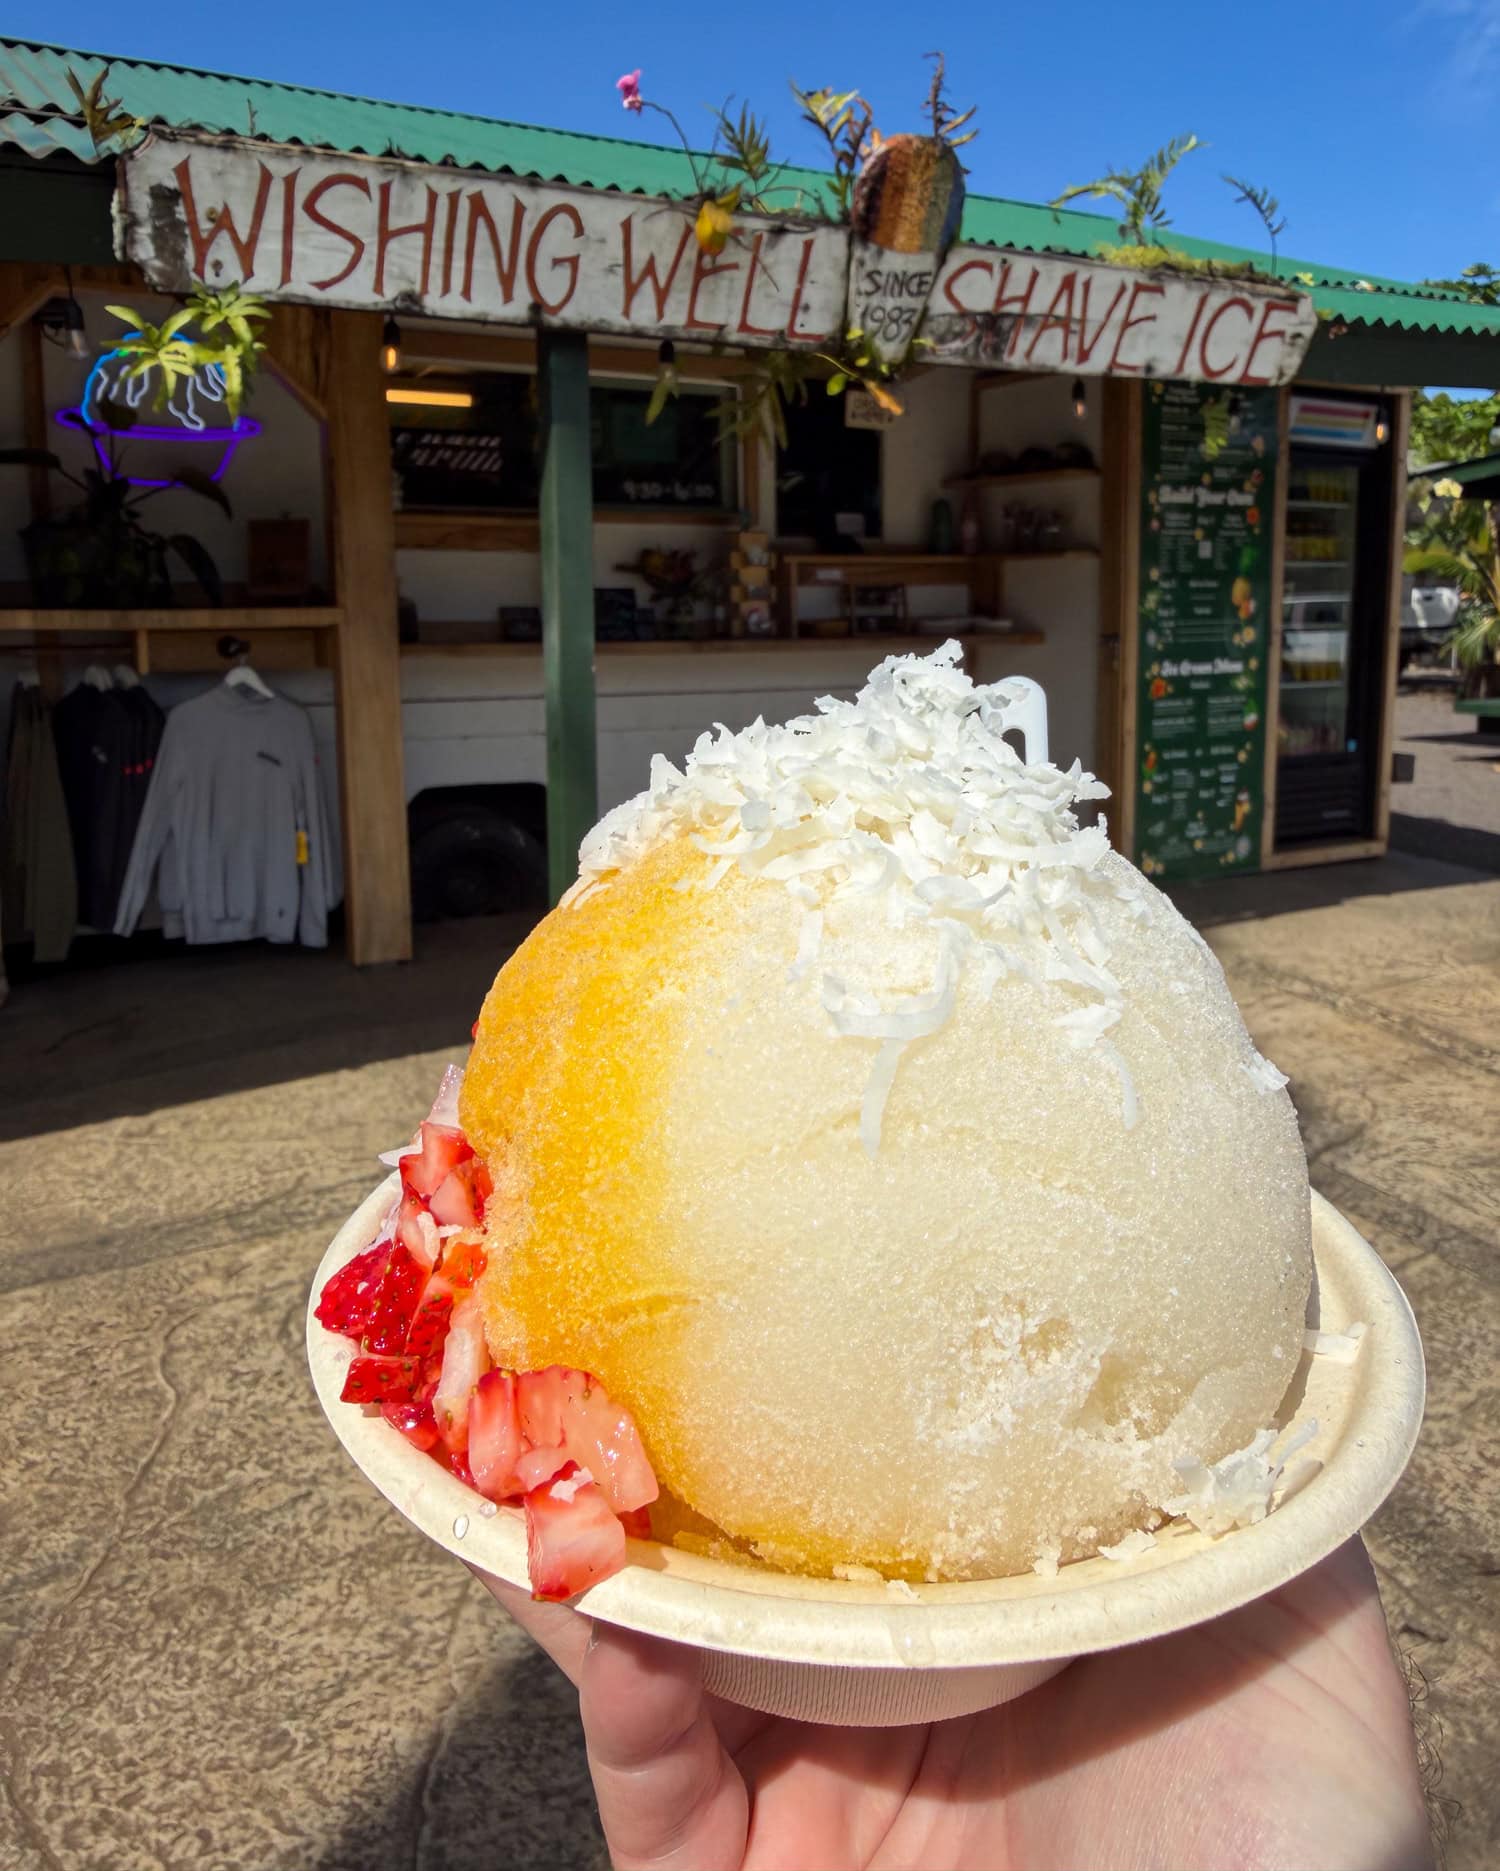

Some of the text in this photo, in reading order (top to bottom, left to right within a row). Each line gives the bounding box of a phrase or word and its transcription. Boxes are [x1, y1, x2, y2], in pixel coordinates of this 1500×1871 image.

[174, 154, 826, 342] WISHING WELL
[863, 270, 932, 298] SINCE
[861, 304, 926, 344] 1983
[939, 260, 1299, 384] SHAVE ICE
